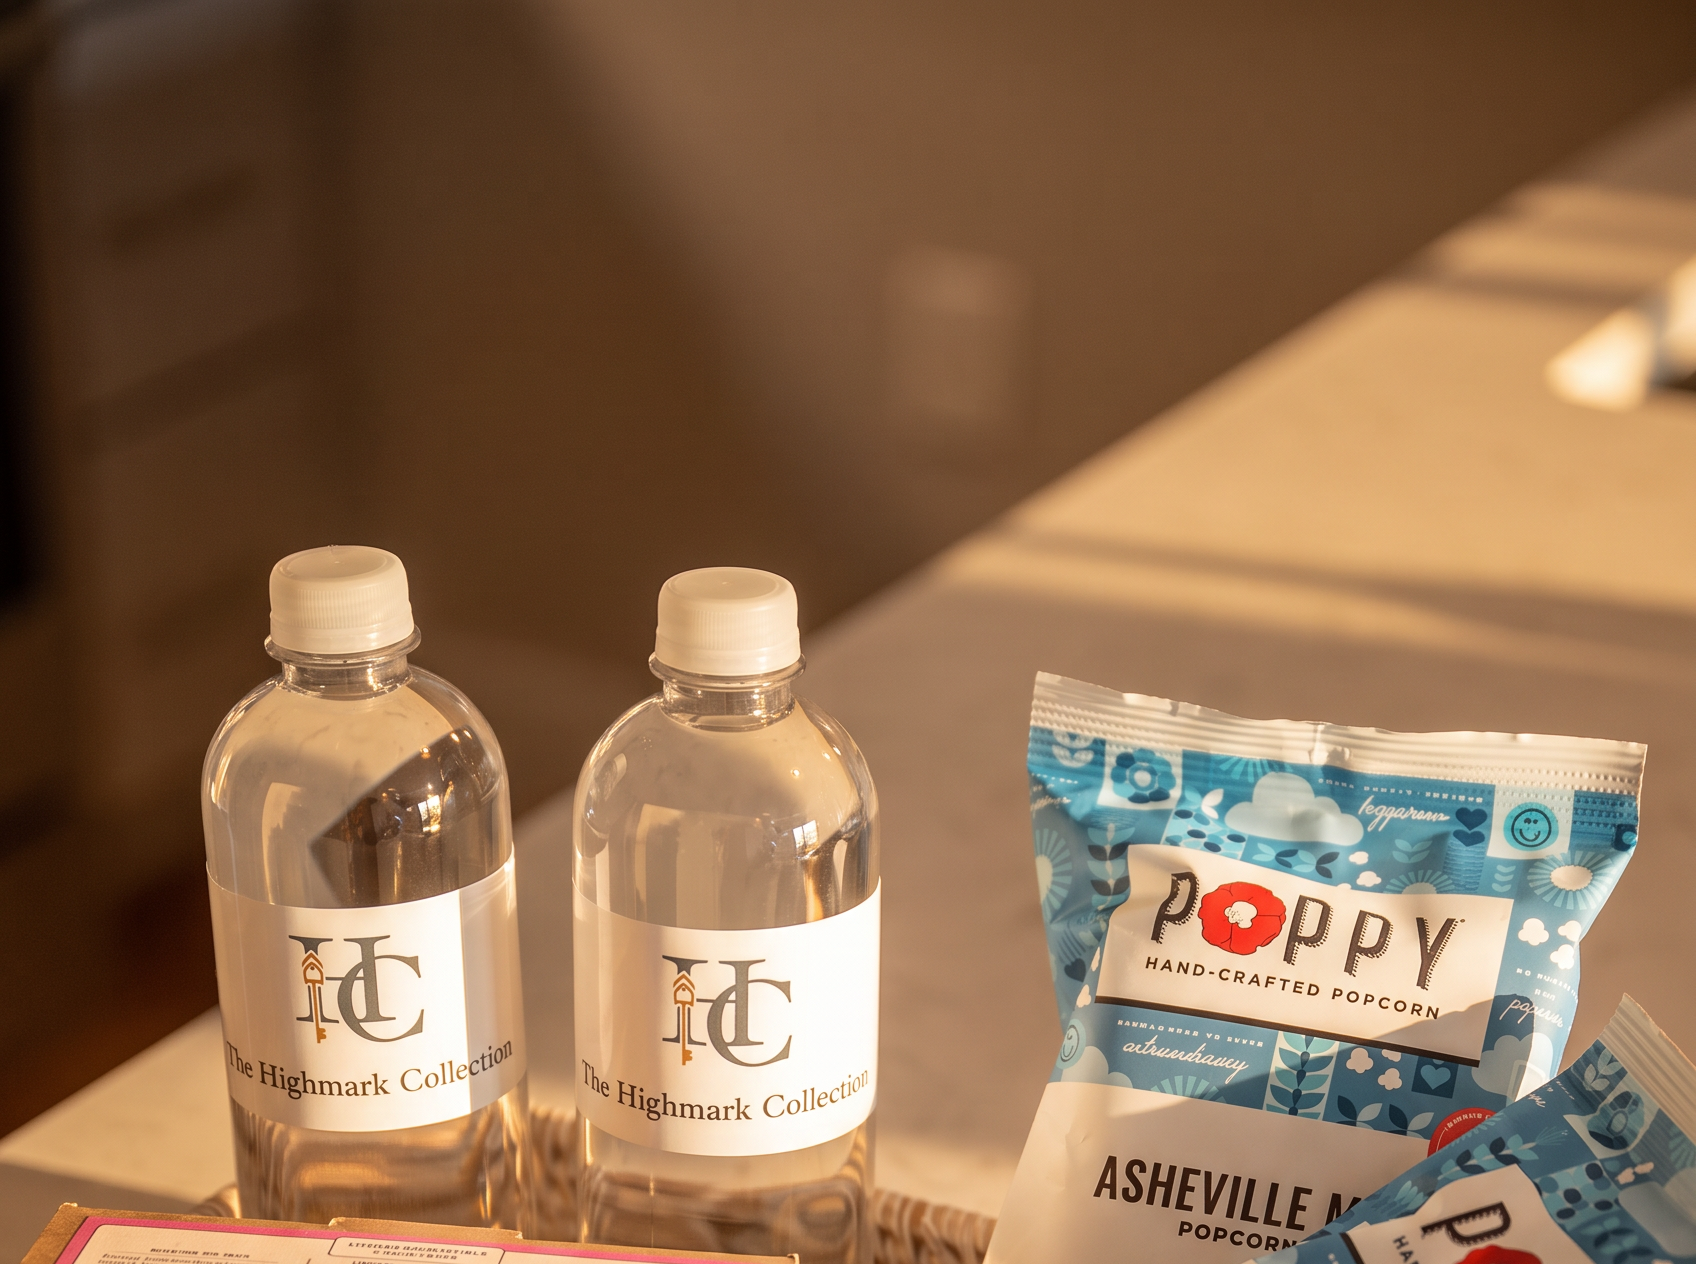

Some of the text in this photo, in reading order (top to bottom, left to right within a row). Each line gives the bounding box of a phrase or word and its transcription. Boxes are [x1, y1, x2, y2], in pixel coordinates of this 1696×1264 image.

[1145, 956, 1440, 1019] HAND-CRAFTED POPCORN
[226, 1040, 513, 1100] The Highmark Collection
[581, 1058, 869, 1121] The Highmark Collection
[1093, 1155, 1313, 1231] ASHEVILLE
